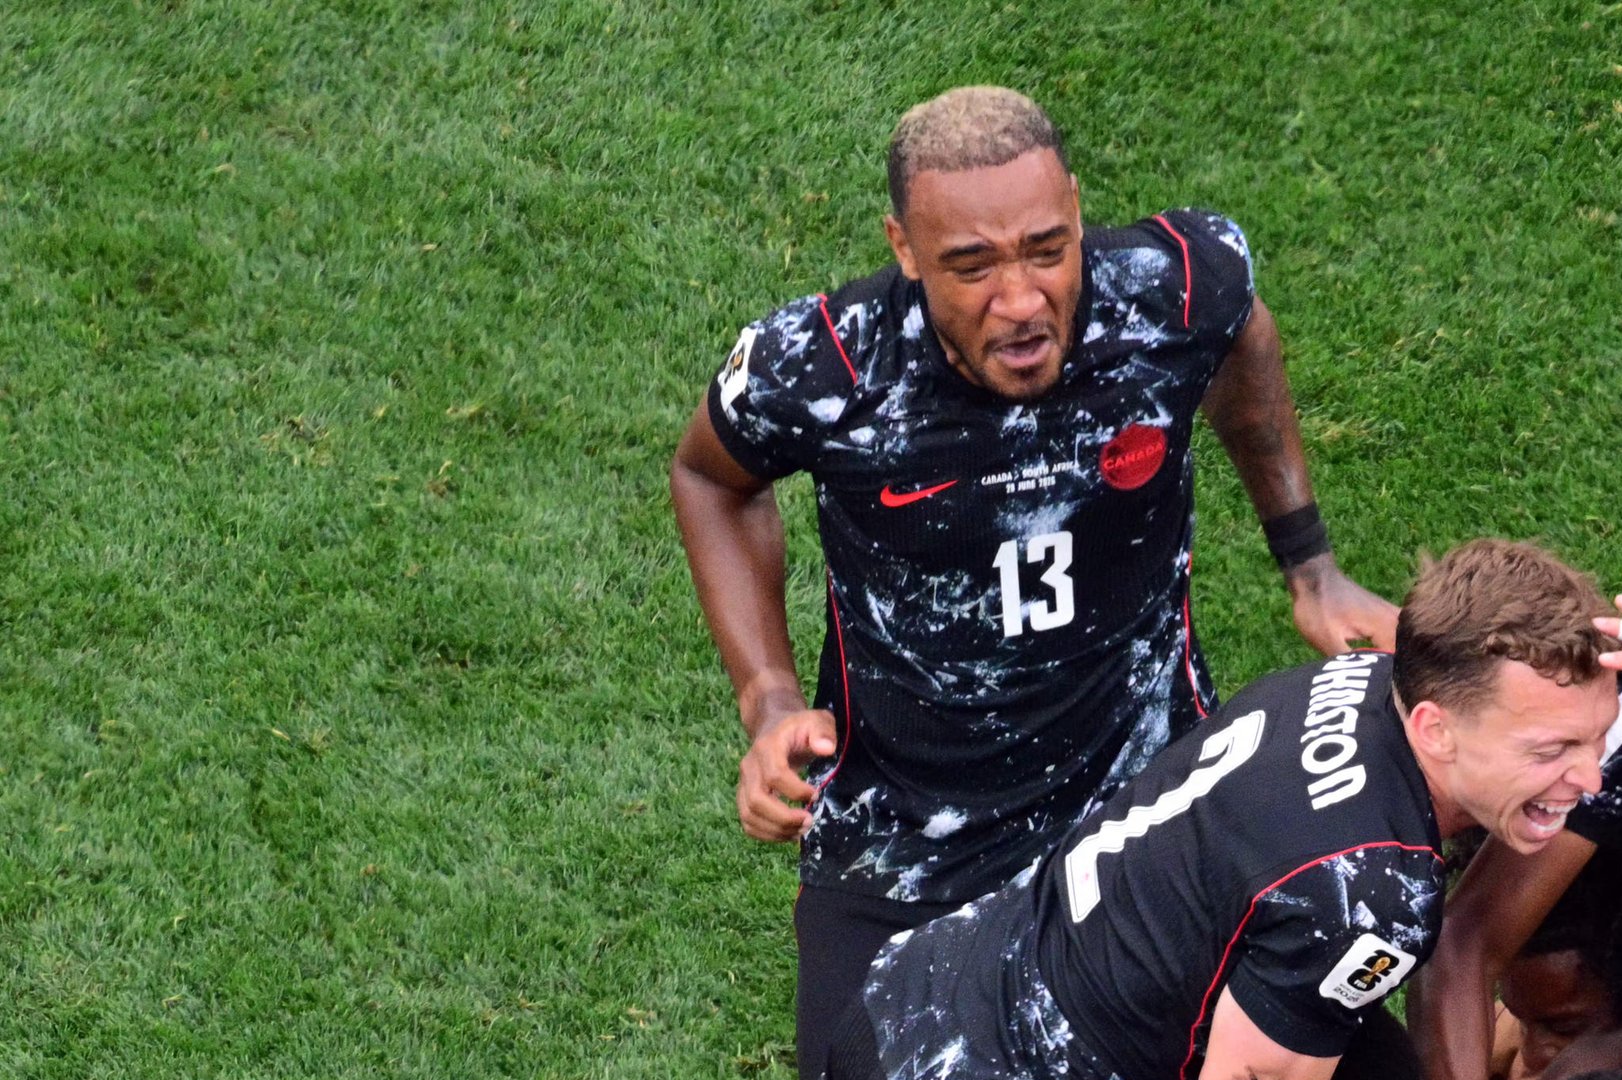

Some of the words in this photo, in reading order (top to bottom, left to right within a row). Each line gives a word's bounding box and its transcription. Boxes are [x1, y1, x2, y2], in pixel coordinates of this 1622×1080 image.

[981, 471, 1012, 485] CANADA
[1022, 464, 1049, 479] SOUTH
[1018, 479, 1036, 491] JUNE
[1103, 442, 1163, 470] CANADA
[992, 530, 1075, 638] 13
[1301, 653, 1379, 811] OHNSTON
[1065, 710, 1266, 923] 2
